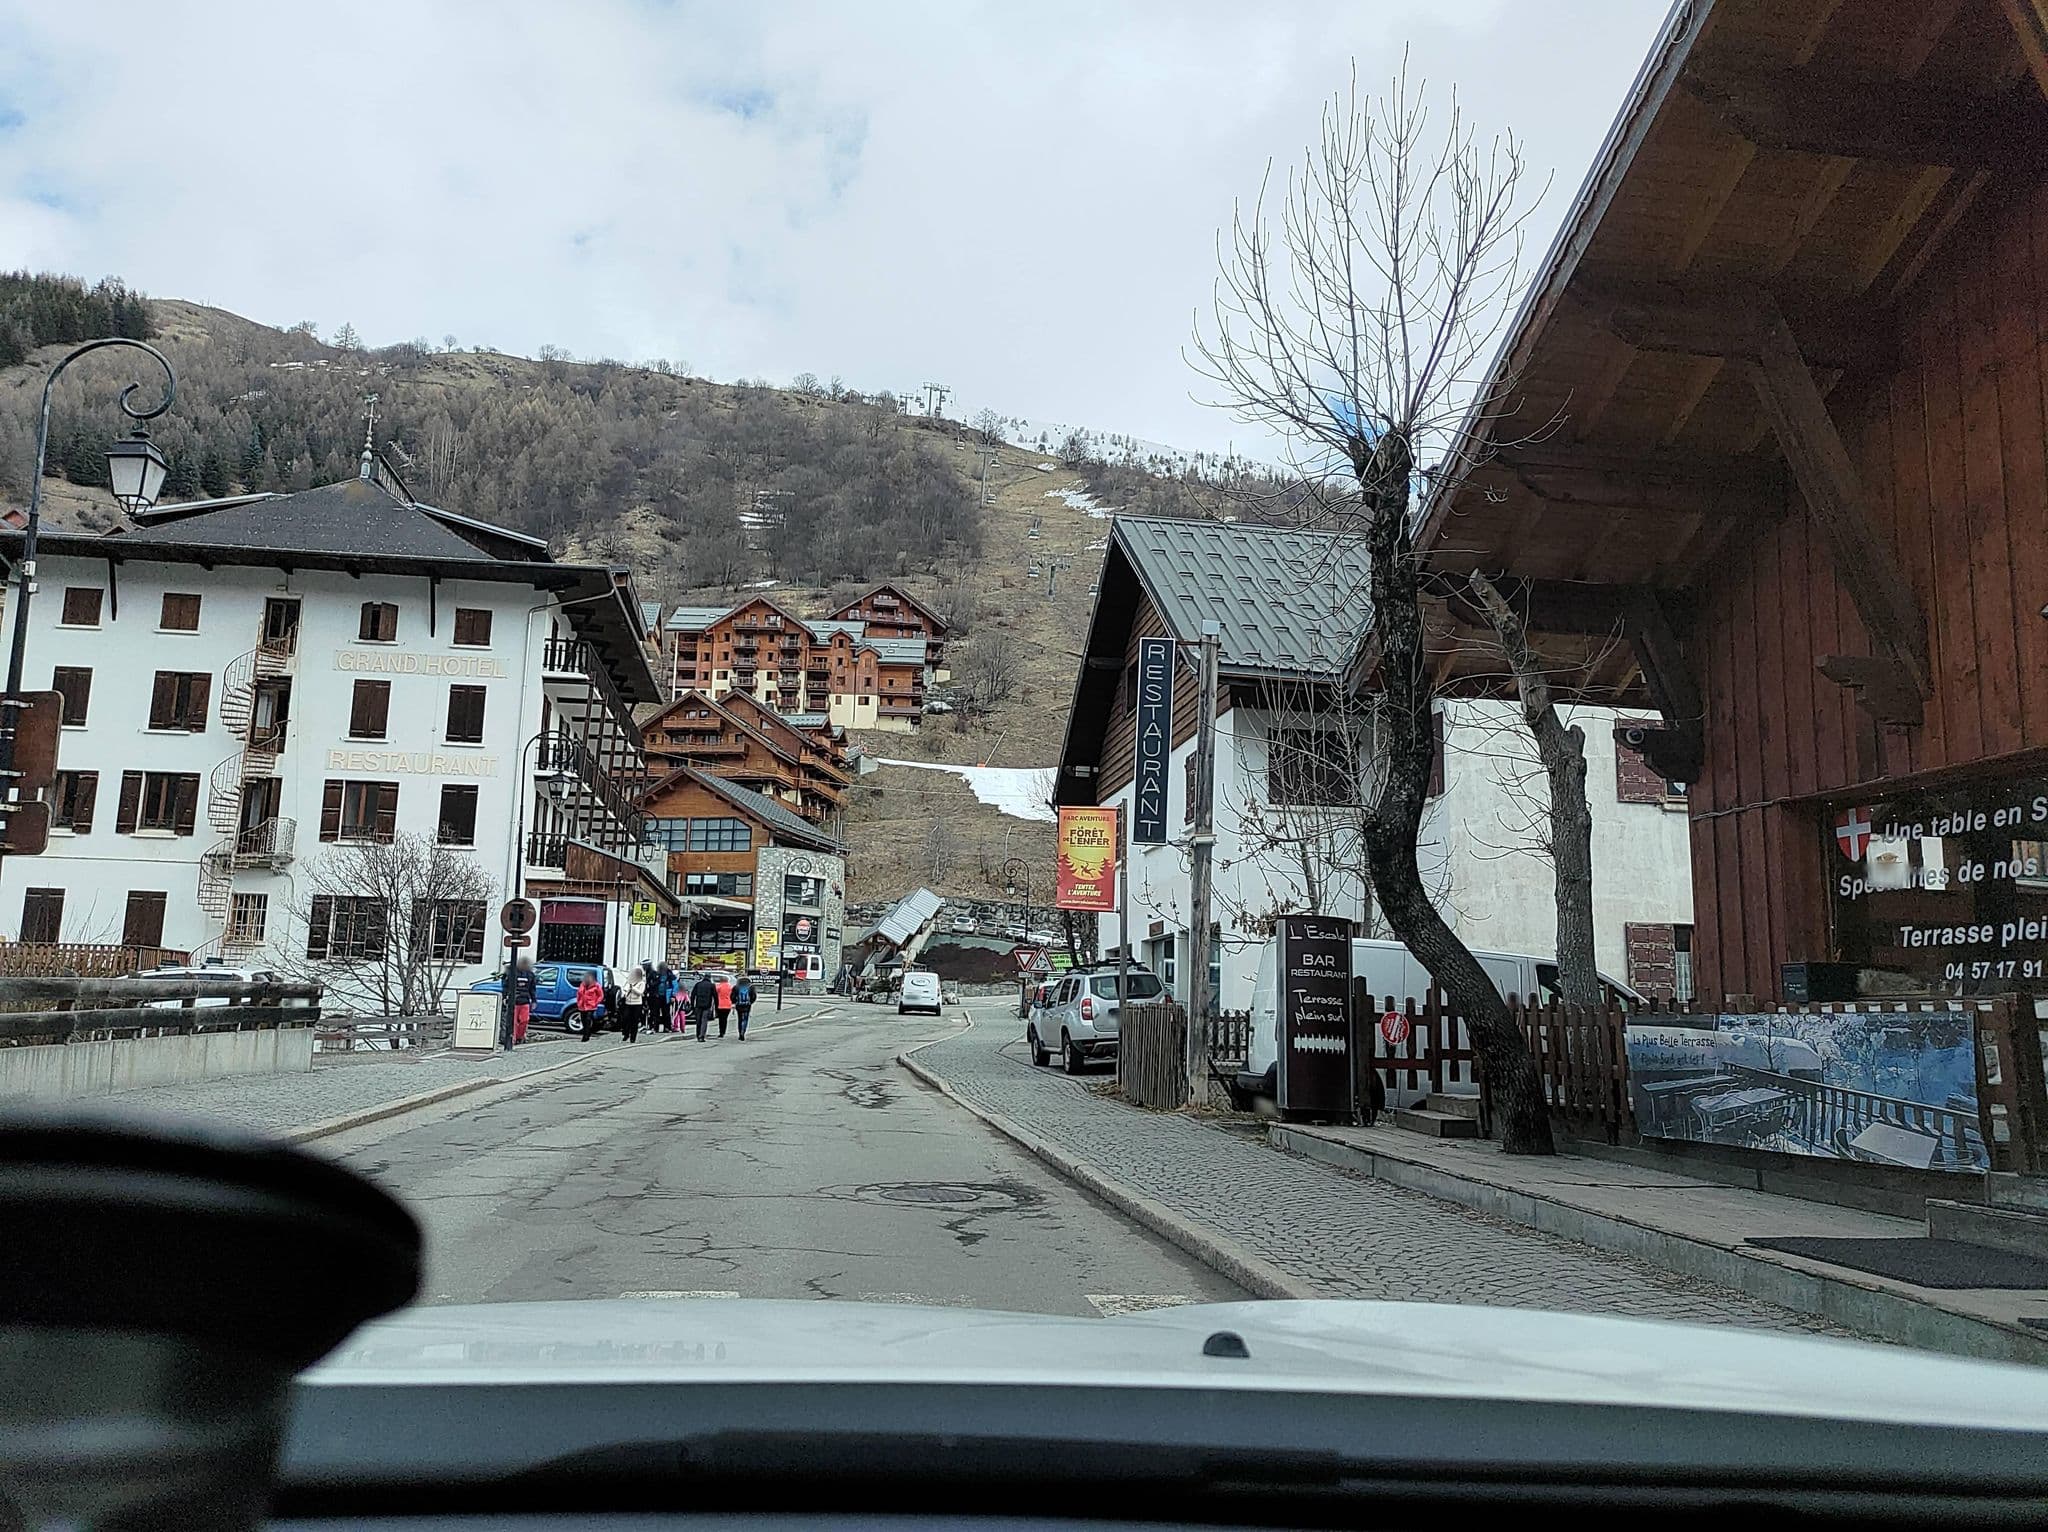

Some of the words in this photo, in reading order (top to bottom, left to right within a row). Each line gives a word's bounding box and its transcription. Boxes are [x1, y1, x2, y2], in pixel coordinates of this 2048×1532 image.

[337, 651, 419, 674] GRAND
[425, 655, 508, 679] HOTEL
[1139, 644, 1166, 837] RESTAURANT
[328, 750, 498, 777] RESTAURANT
[1885, 822, 1924, 844] Une
[1931, 809, 1986, 837] table
[1993, 805, 2022, 827] en
[1070, 836, 1110, 846] L'ENFER
[1958, 860, 1985, 883] de
[1993, 857, 2038, 879] nos
[1289, 924, 1347, 941] L'Escale
[1900, 924, 1994, 948] Terrasse
[1302, 954, 1336, 967] BAR
[1945, 962, 1964, 980] 04
[1971, 962, 1990, 979] 57
[1996, 960, 2016, 979] 17
[2023, 959, 2042, 978] 91
[1290, 968, 1348, 980] RESTAURANT
[1292, 989, 1344, 1005] Terrasse
[1294, 1007, 1327, 1026] plein
[1327, 1008, 1346, 1022] sud
[1642, 1034, 1658, 1048] Plus
[1660, 1034, 1679, 1048] Belle
[1680, 1033, 1715, 1048] Terrasse
